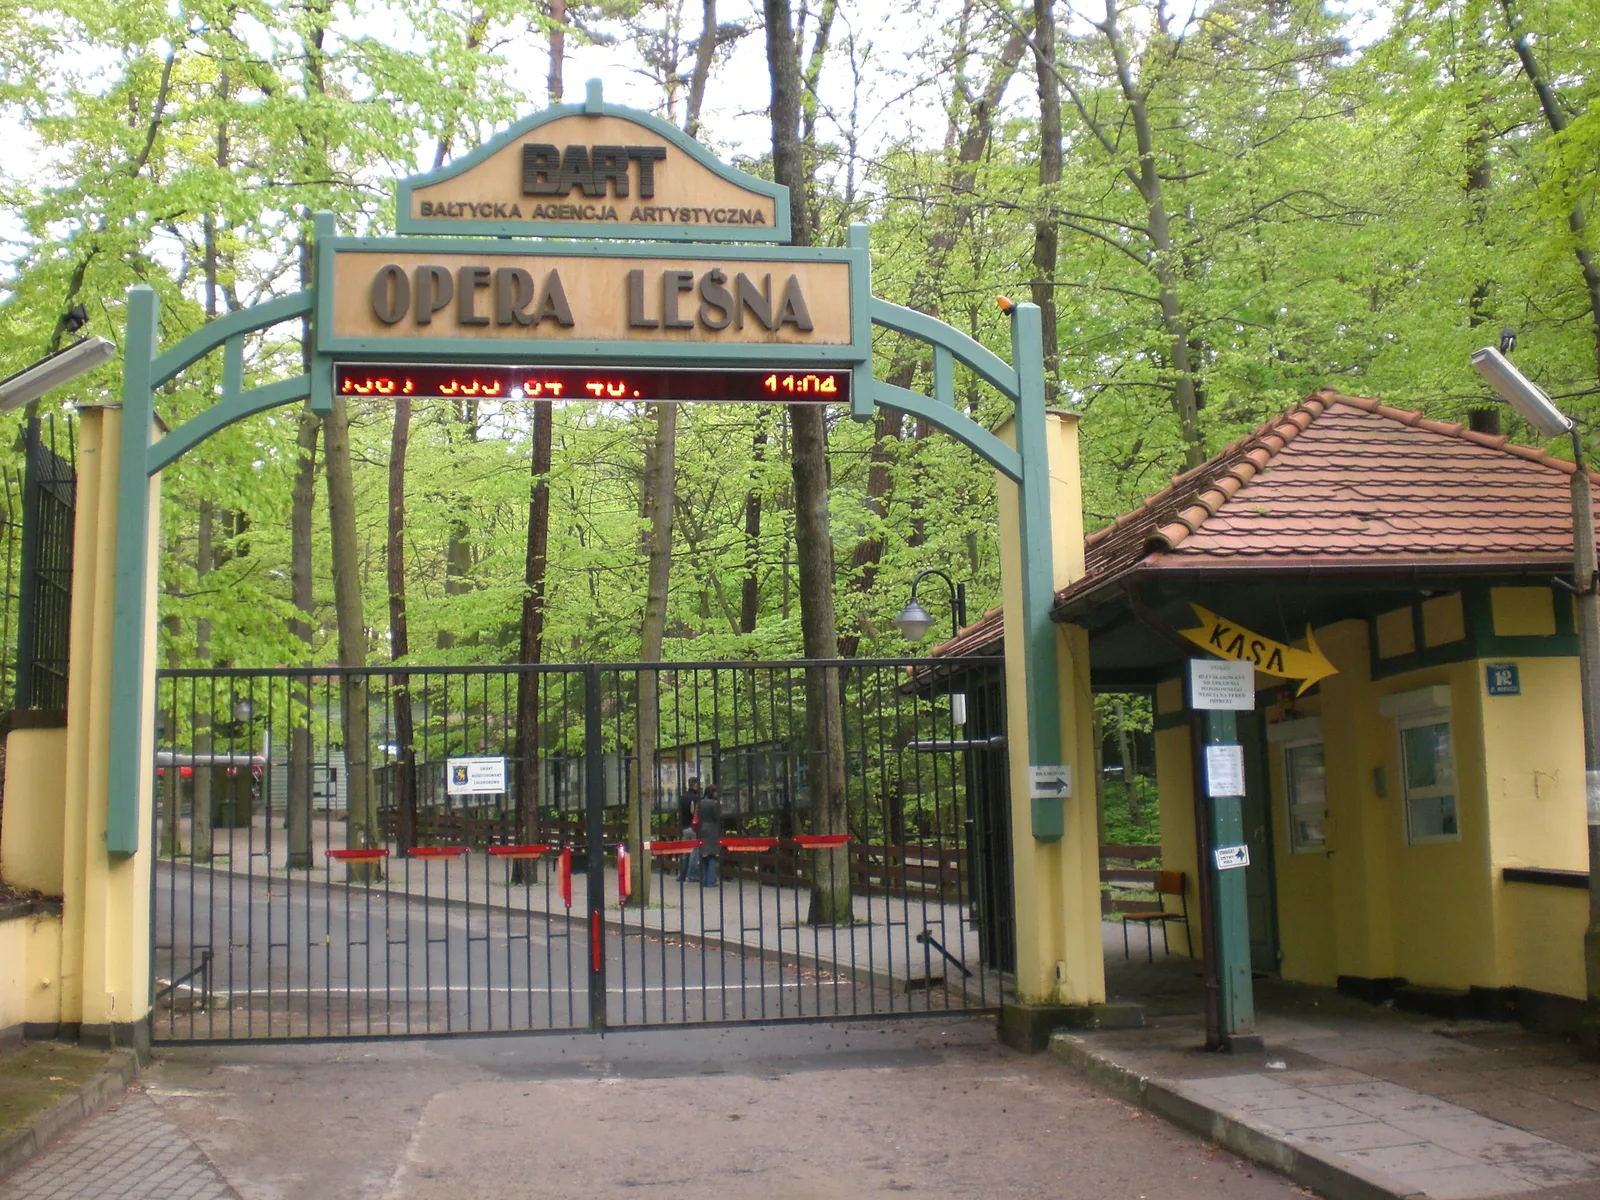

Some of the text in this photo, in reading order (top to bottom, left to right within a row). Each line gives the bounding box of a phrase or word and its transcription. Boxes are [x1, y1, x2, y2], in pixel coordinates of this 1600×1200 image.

[522, 143, 667, 199] BART
[420, 202, 766, 225] BAŁTYCKA AGENCJA ARTYSTYCZNA
[371, 263, 815, 332] OPERA LEŚNA
[1209, 623, 1285, 673] KASA
[1495, 670, 1513, 686] 12
